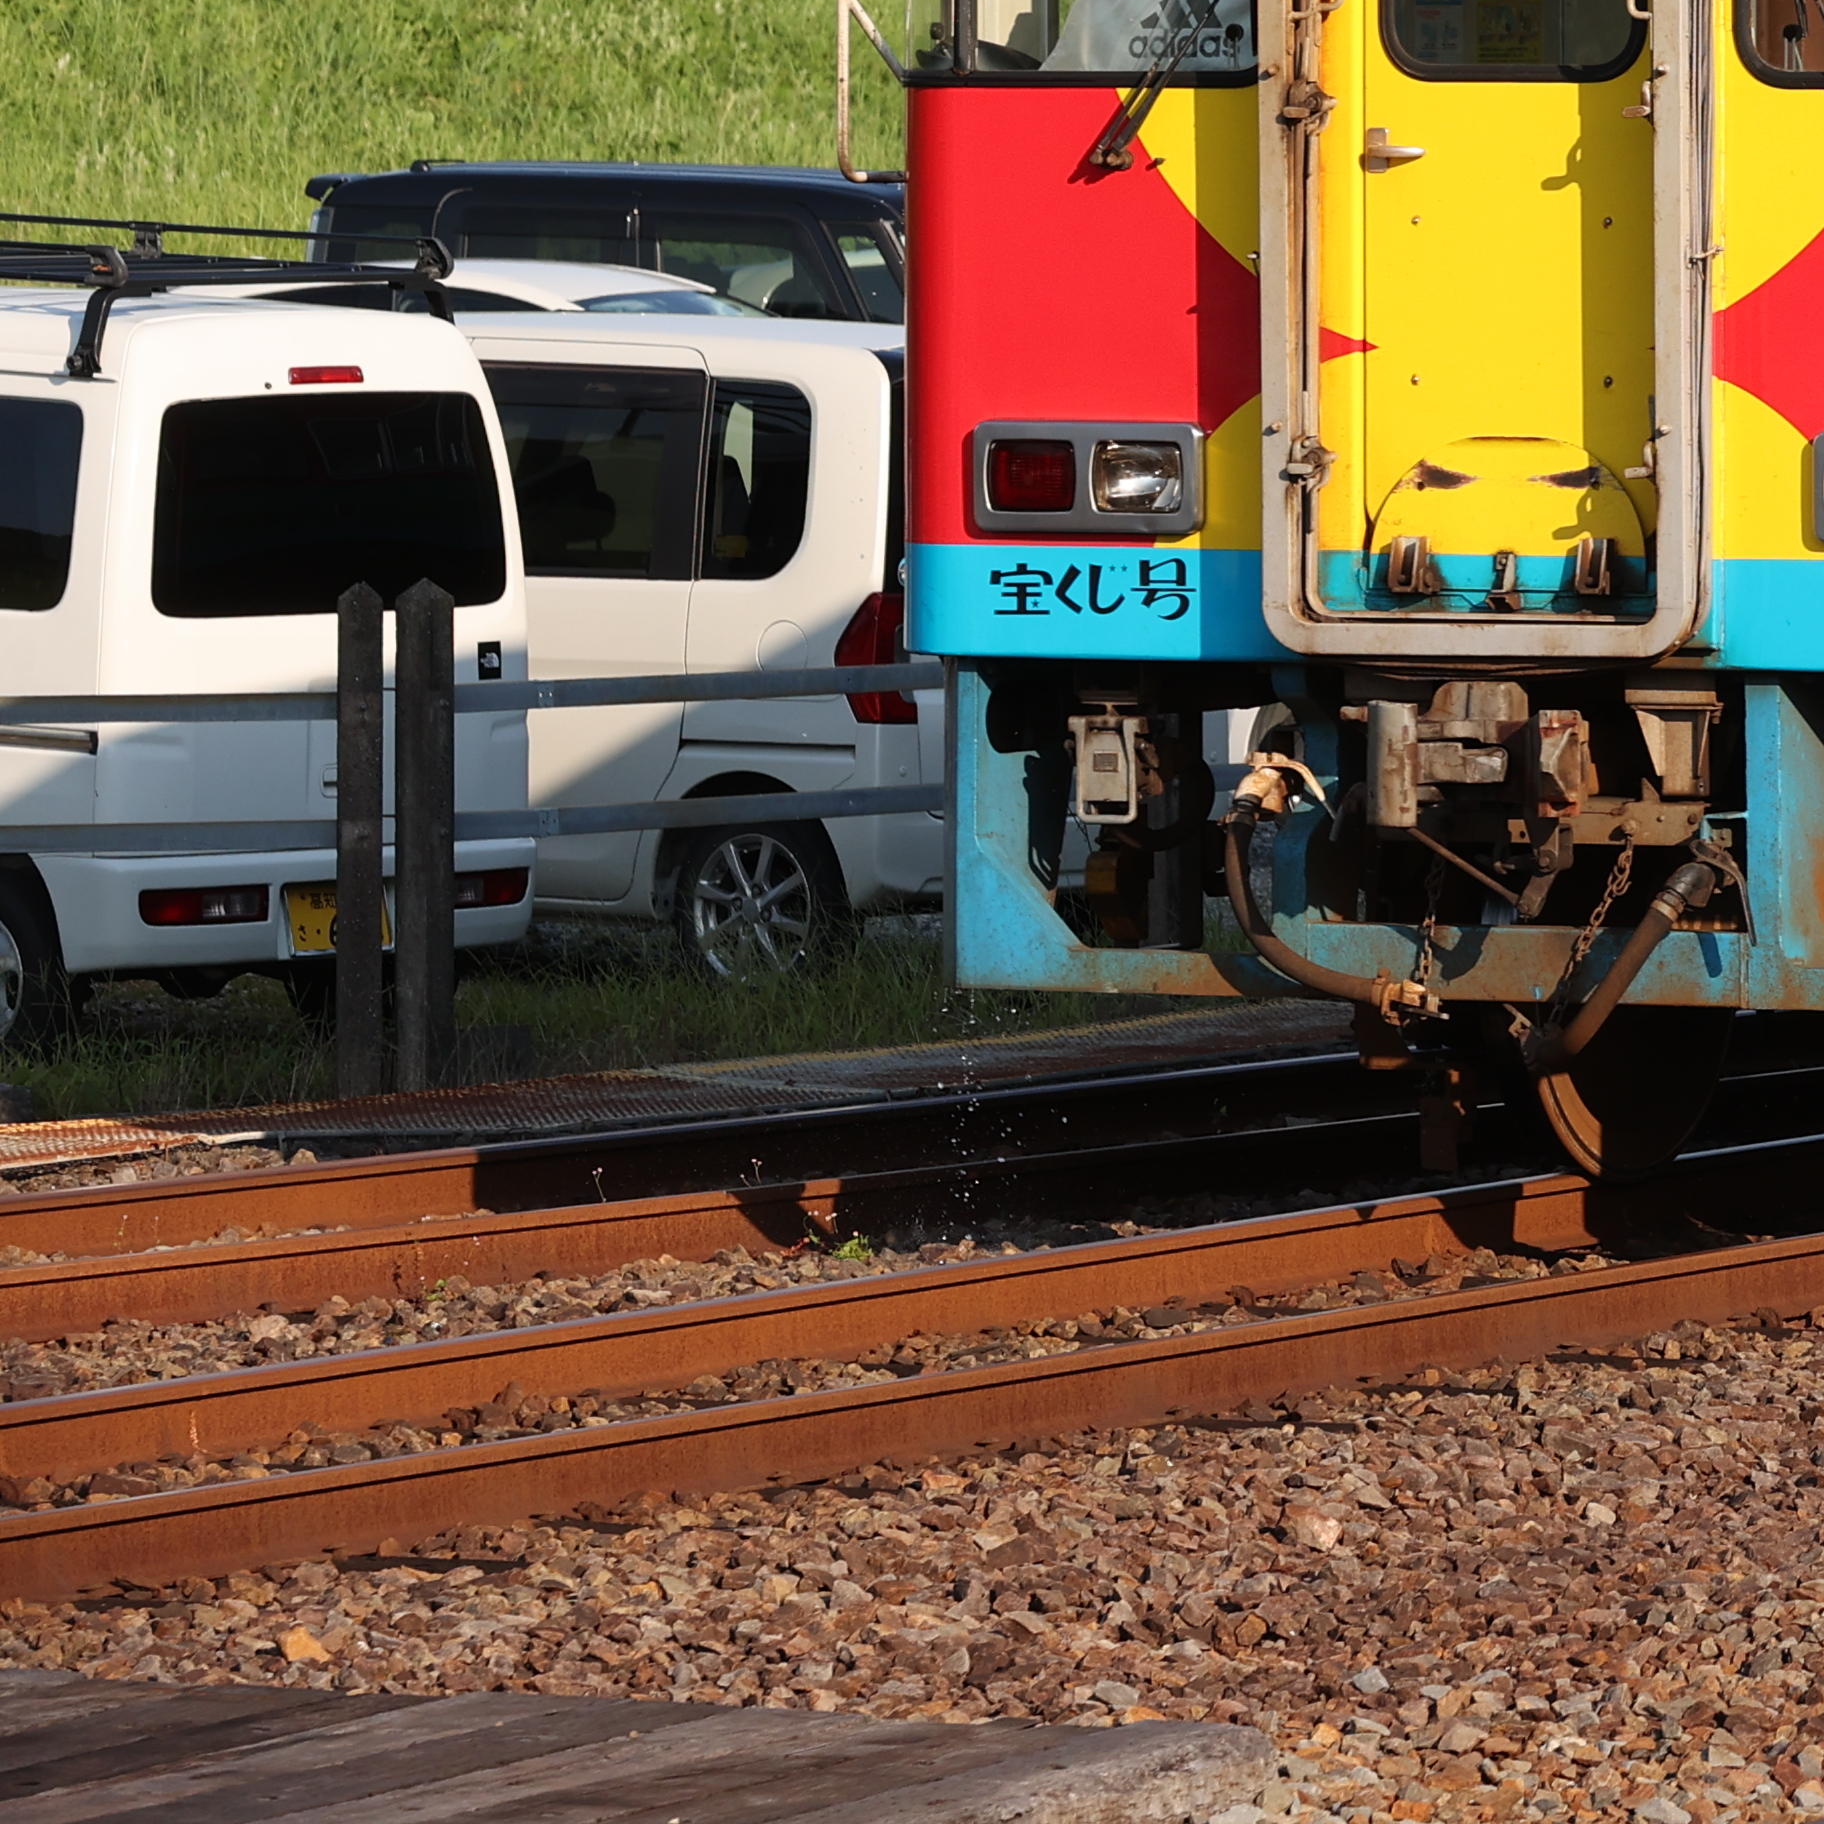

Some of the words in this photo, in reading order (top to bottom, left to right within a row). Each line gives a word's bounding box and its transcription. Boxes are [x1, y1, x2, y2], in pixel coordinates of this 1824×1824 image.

[1129, 28, 1241, 59] adidas
[989, 558, 1197, 620] 宝くじ号
